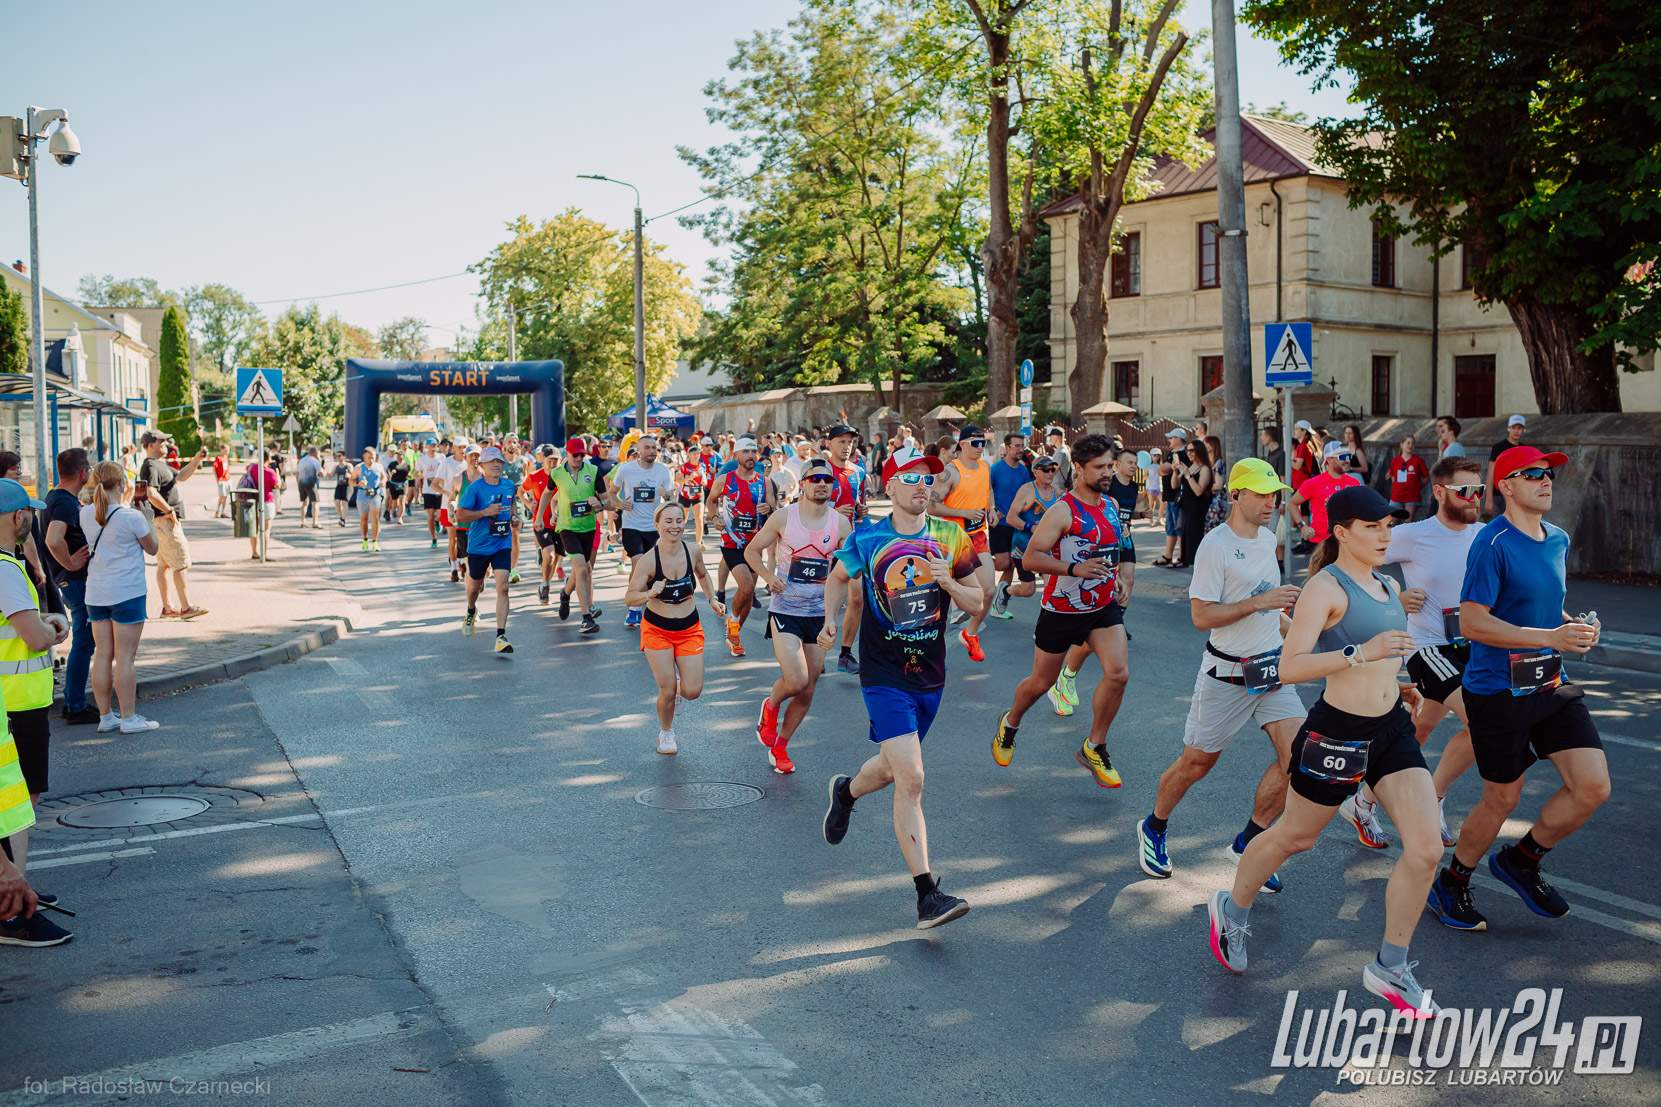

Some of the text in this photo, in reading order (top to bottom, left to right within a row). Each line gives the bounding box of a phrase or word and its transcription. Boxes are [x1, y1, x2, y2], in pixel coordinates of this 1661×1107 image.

[429, 370, 490, 386] START
[802, 567, 816, 577] 46
[672, 589, 679, 597] 4
[908, 599, 927, 614] 75
[1260, 664, 1278, 680] 78
[1535, 666, 1544, 680] 5
[1323, 755, 1346, 771] 60
